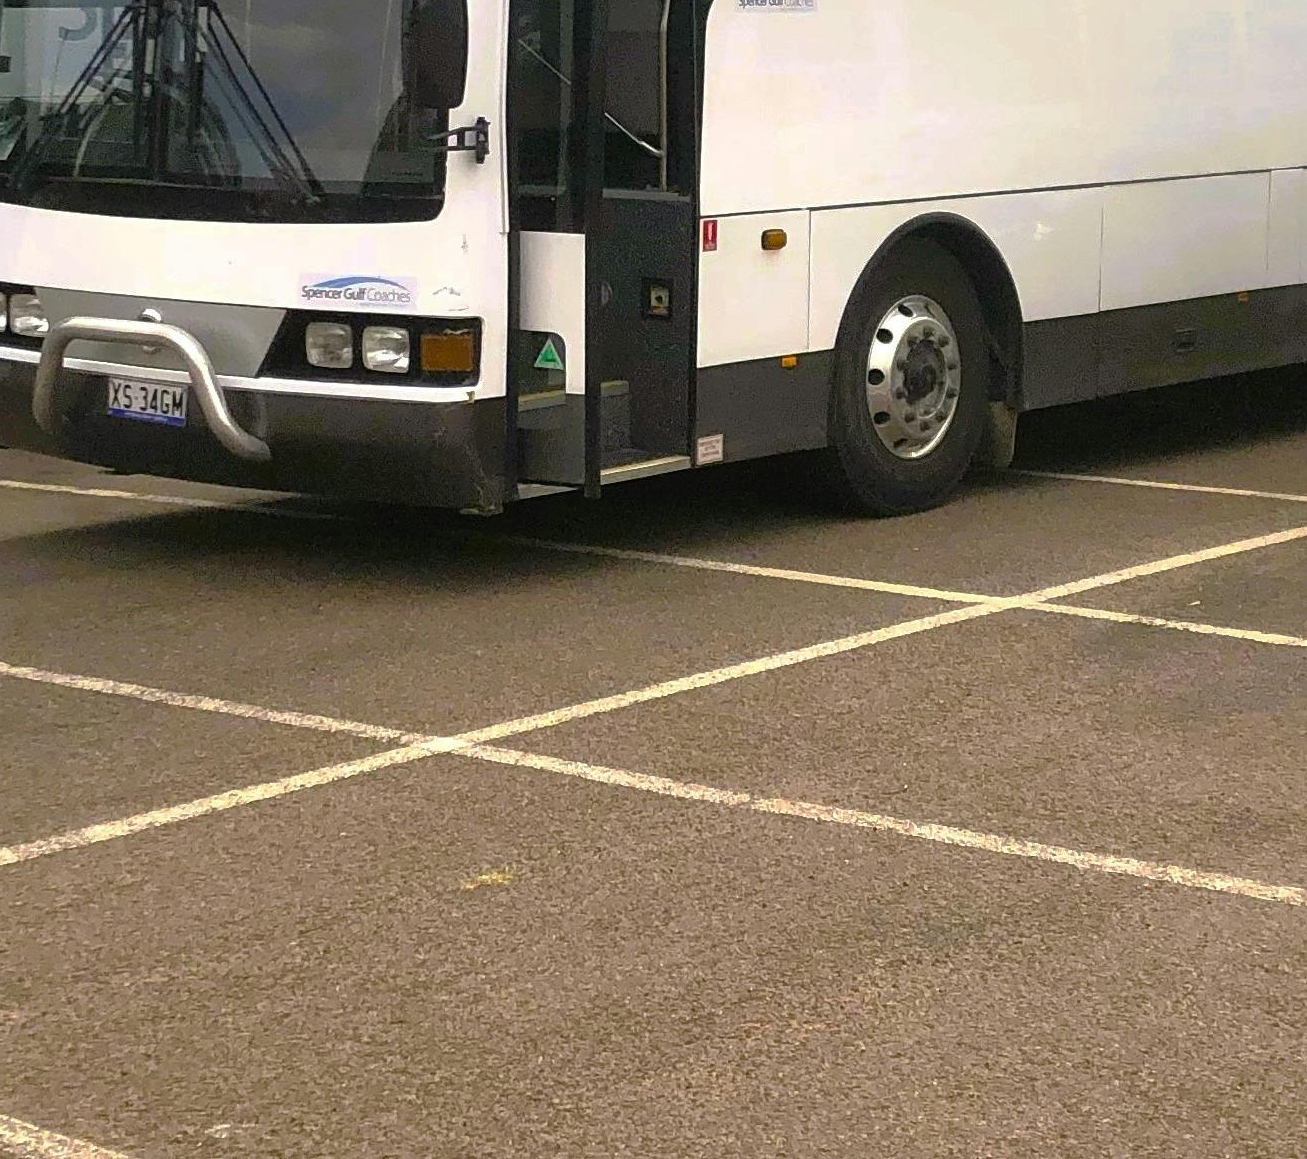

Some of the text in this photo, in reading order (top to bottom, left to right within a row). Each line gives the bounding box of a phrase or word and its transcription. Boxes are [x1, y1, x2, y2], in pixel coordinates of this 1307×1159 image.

[301, 285, 411, 303] Spencer Gulf Coaches
